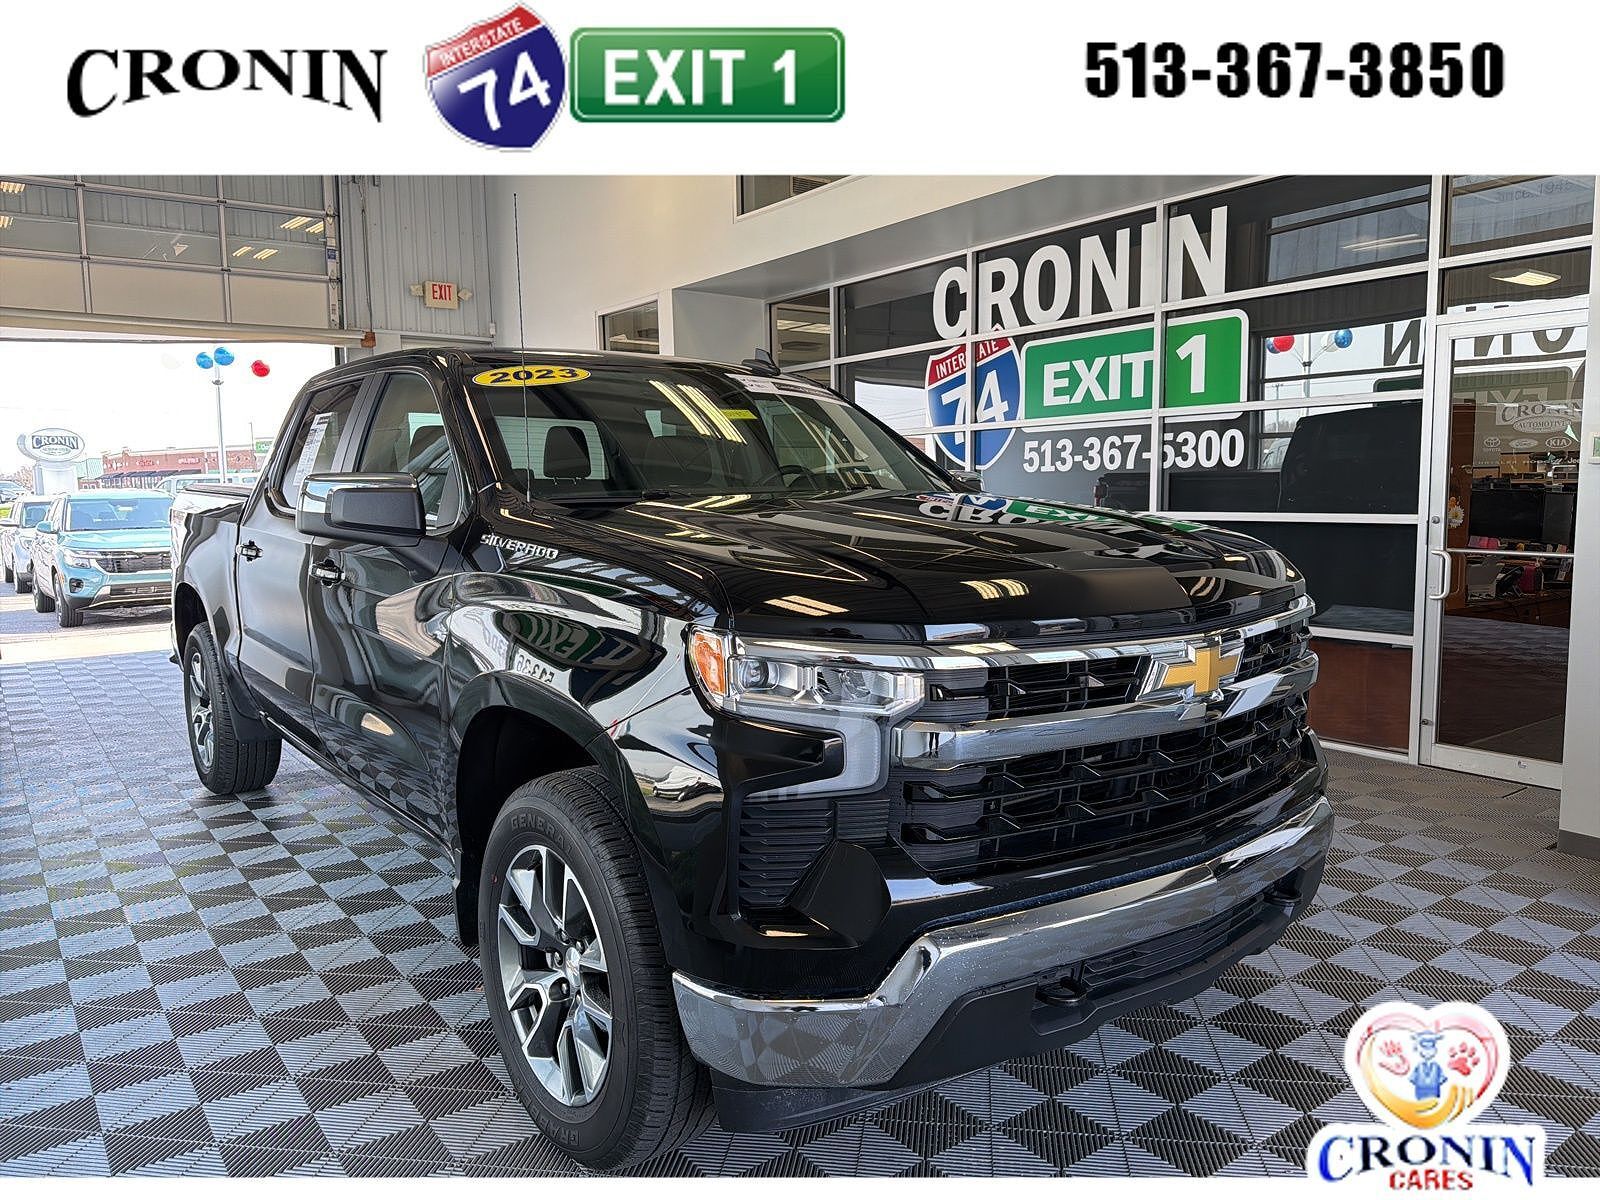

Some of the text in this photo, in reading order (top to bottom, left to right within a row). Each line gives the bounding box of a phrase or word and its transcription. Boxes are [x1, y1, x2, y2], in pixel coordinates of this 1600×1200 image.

[432, 283, 452, 301] EXIT
[932, 205, 1229, 341] CRONIN
[489, 367, 579, 384] 2023
[935, 338, 1000, 380] INTERATE
[1043, 333, 1207, 407] EXIT 1
[941, 368, 1009, 446] 74
[32, 436, 78, 448] CRONIN
[1022, 429, 1245, 474] 513-367-5300
[480, 533, 559, 559] SILVERADO
[511, 814, 574, 855] GENERAL
